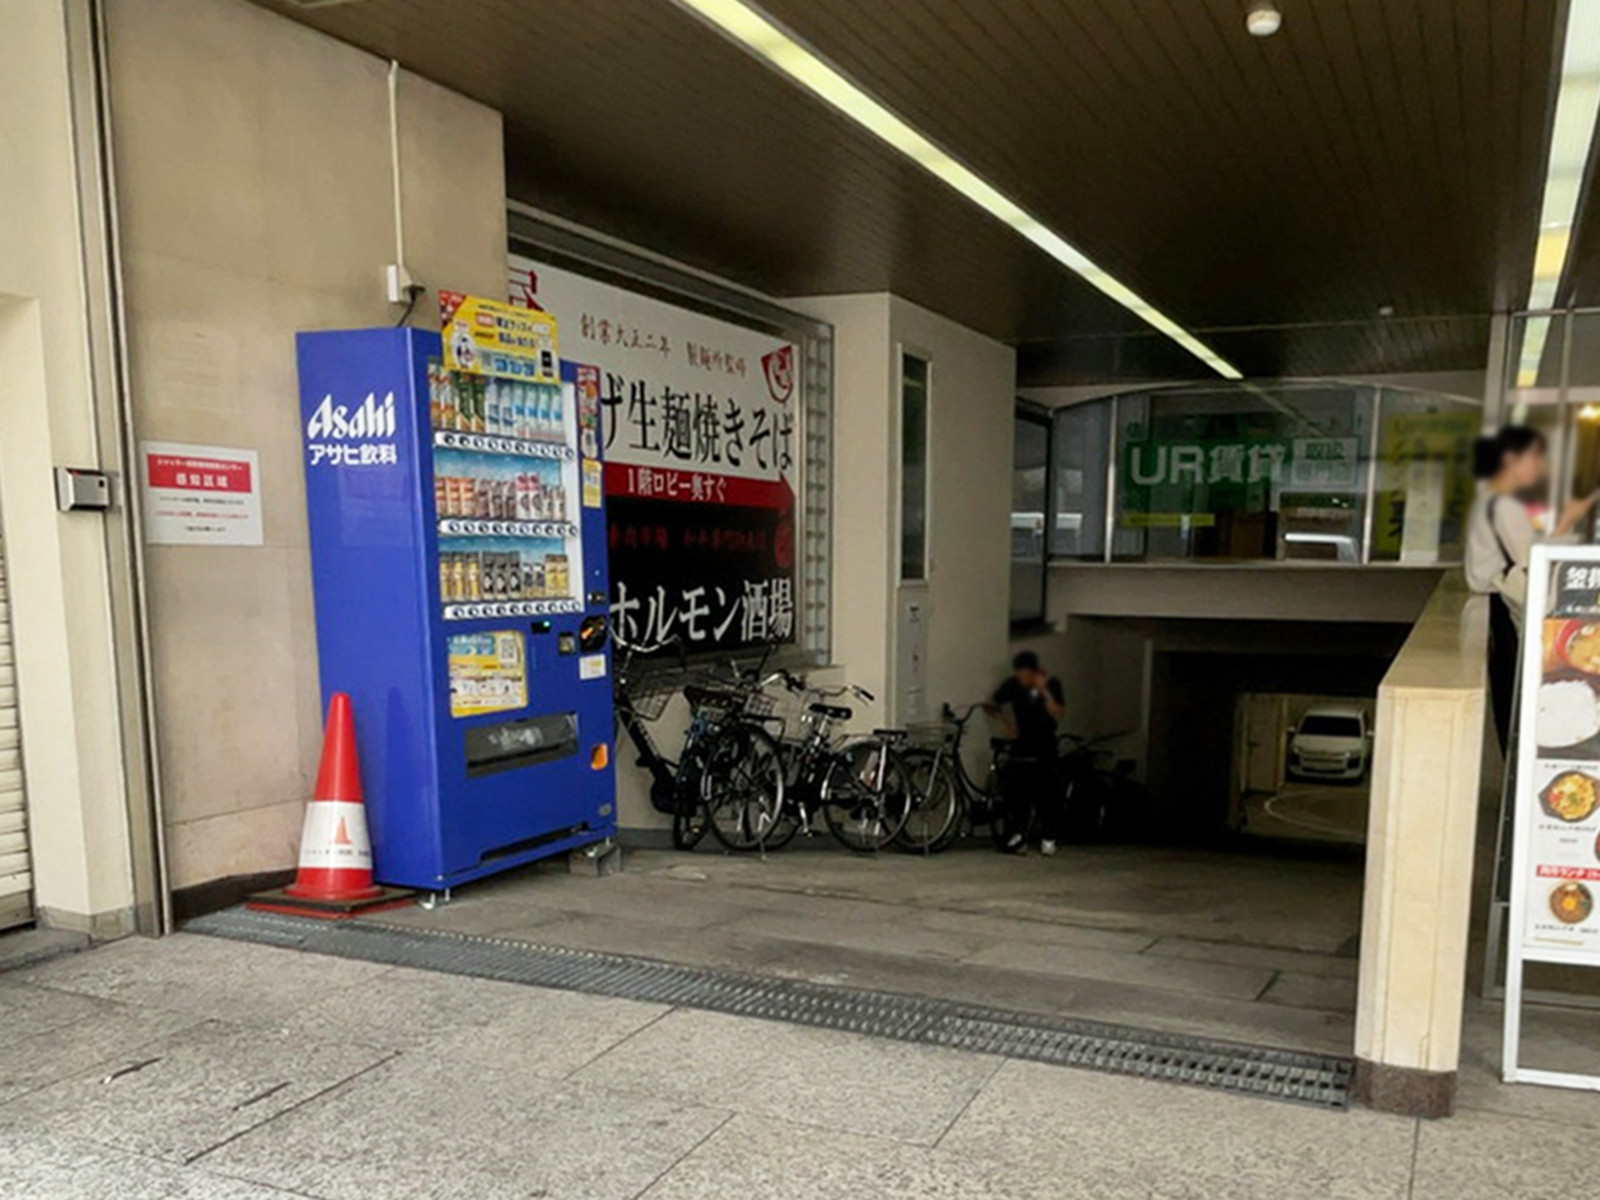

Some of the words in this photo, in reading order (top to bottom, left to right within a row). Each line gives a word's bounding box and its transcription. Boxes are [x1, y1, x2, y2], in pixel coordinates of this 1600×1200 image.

[307, 392, 395, 439] Asahi
[308, 443, 397, 466] アサヒ飲料
[1131, 443, 1286, 485] UR賃貸
[627, 467, 727, 502] 1階ロビー奥すぐ
[609, 577, 793, 649] ホルモン酒場
